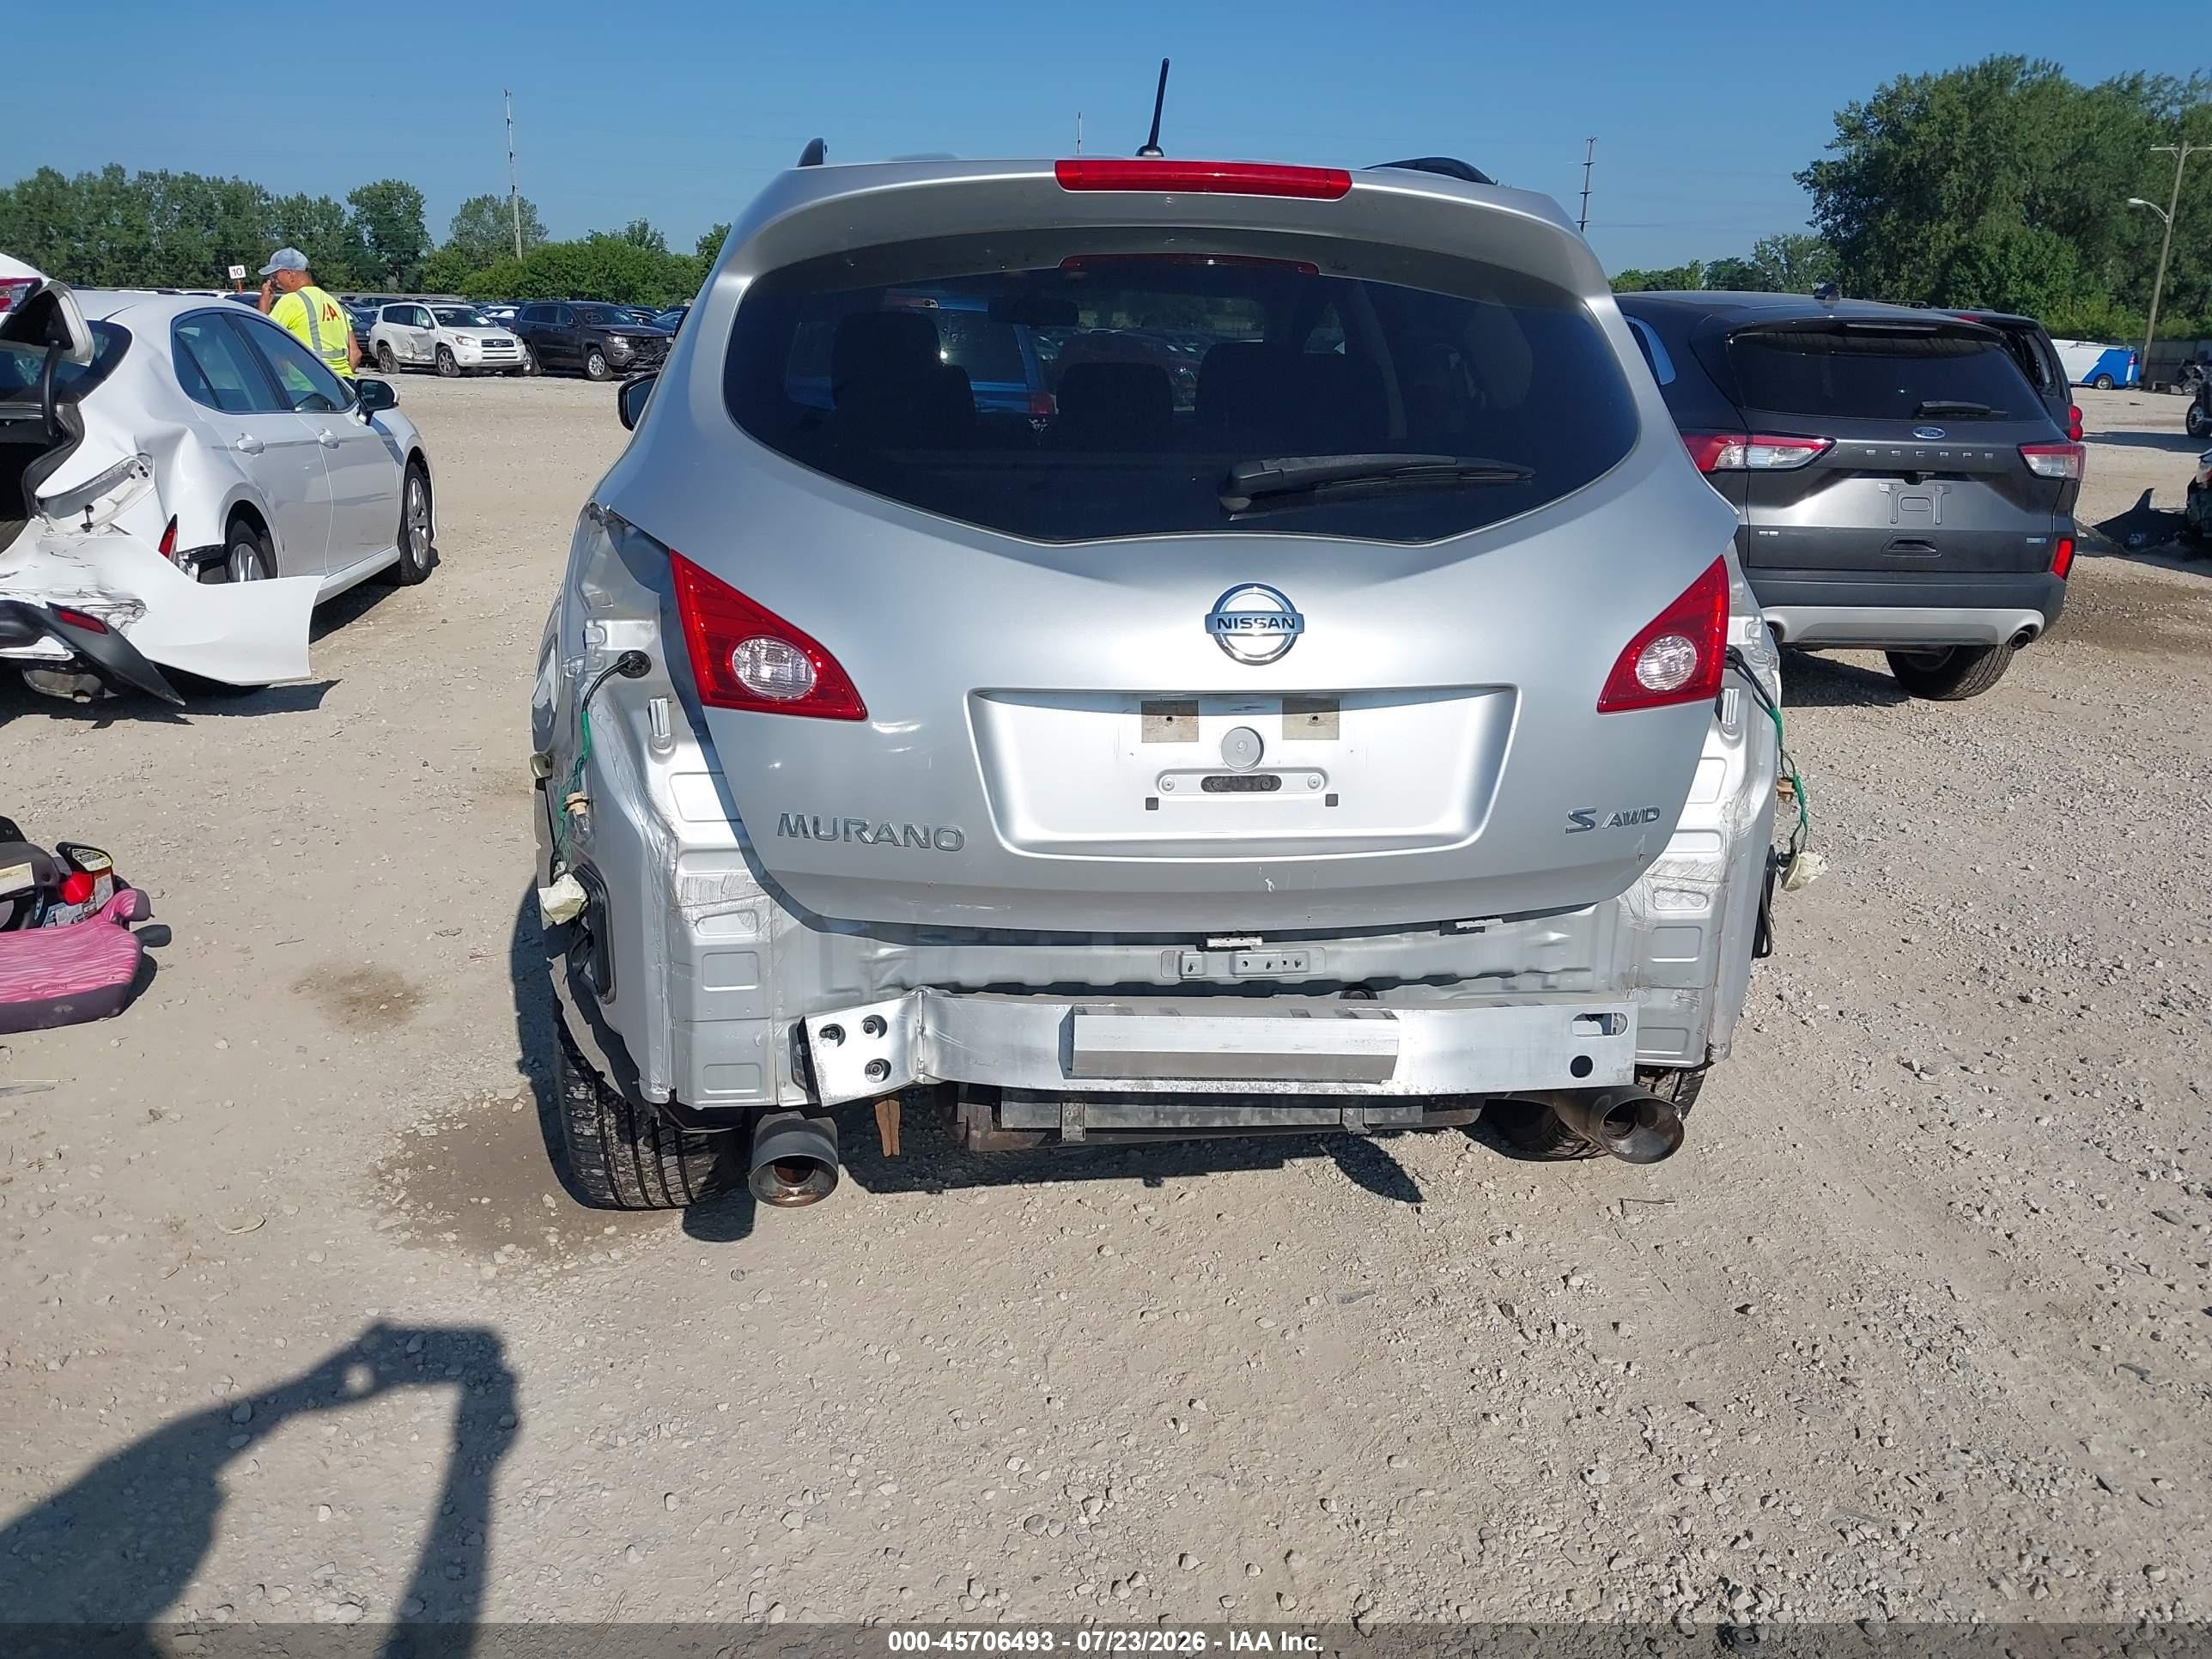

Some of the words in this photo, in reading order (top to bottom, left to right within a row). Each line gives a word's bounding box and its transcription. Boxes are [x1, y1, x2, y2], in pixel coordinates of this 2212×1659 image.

[231, 267, 243, 276] 10
[1866, 449, 1994, 459] ESCAPE
[1217, 617, 1295, 629] NISSAN
[1565, 807, 1596, 834] S
[1601, 806, 1660, 829] AWD
[777, 812, 965, 852] MURANO
